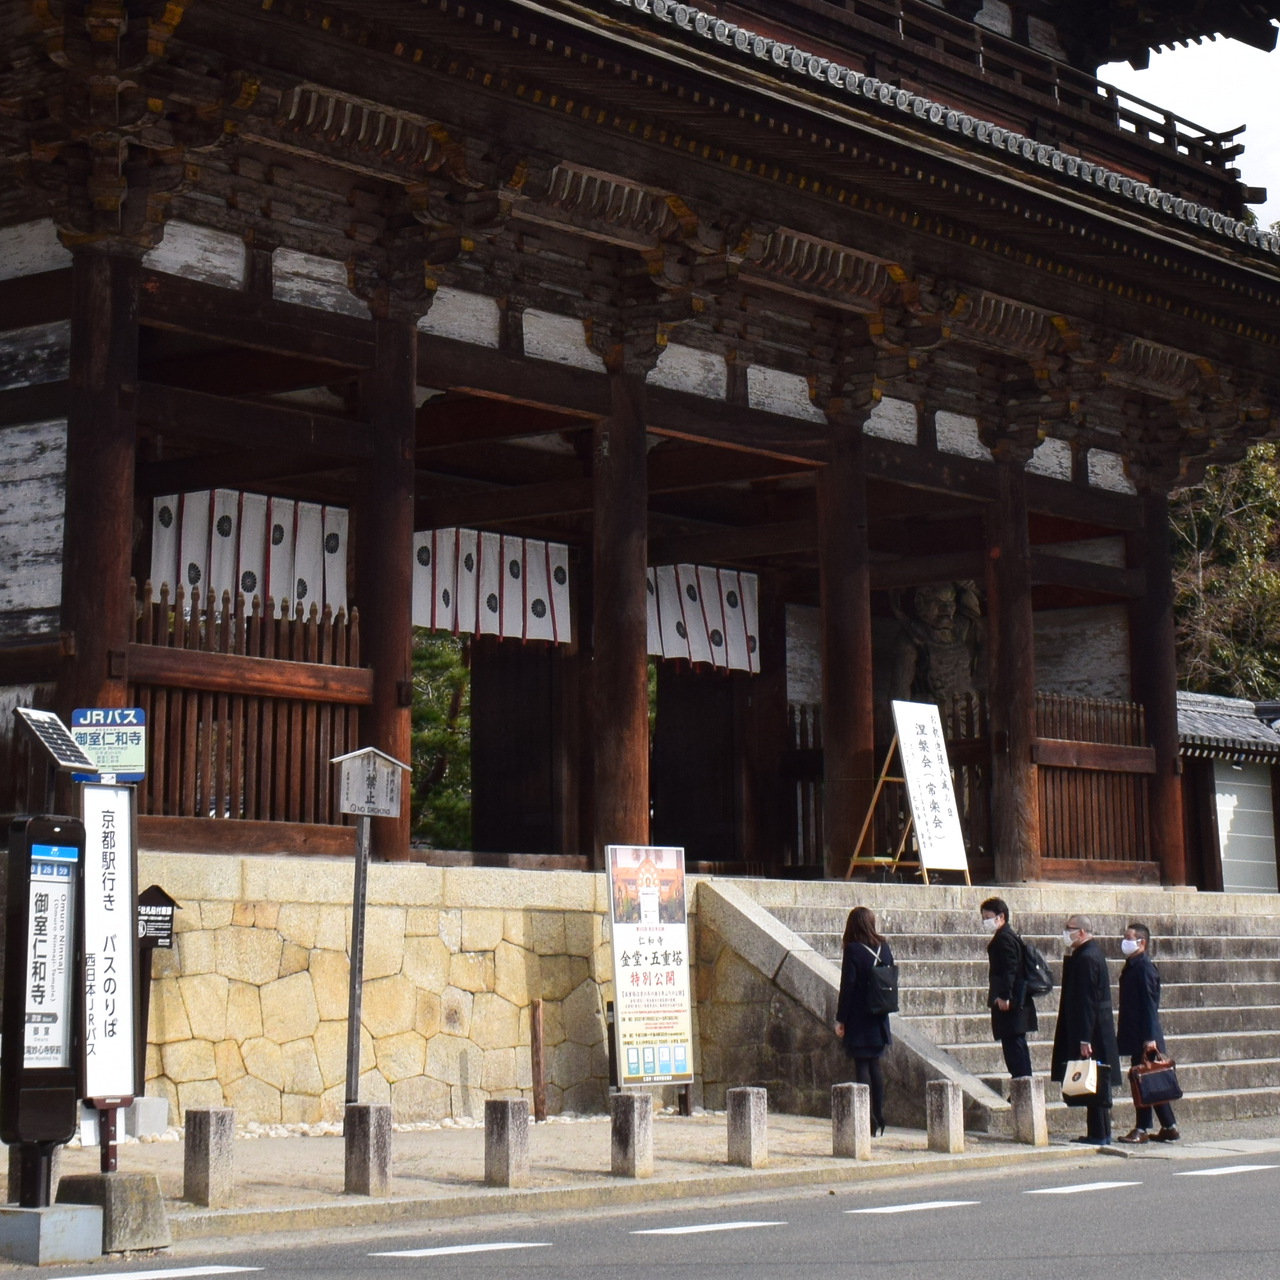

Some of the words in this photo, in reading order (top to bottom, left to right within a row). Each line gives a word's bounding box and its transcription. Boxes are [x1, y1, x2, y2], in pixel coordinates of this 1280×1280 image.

[79, 709, 138, 725] JRバス
[74, 730, 142, 747] 御室仁和寺
[101, 809, 116, 911] 京都駅行き
[42, 865, 52, 874] 26
[58, 866, 68, 875] 59
[30, 892, 49, 1005] 御室仁和寺
[638, 936, 664, 946] 仁和寺
[620, 949, 684, 967] 金堂・五重塔
[103, 933, 118, 1038] バスのりば
[630, 970, 675, 987] 特別公開
[85, 953, 97, 1056] 西日本JRバス
